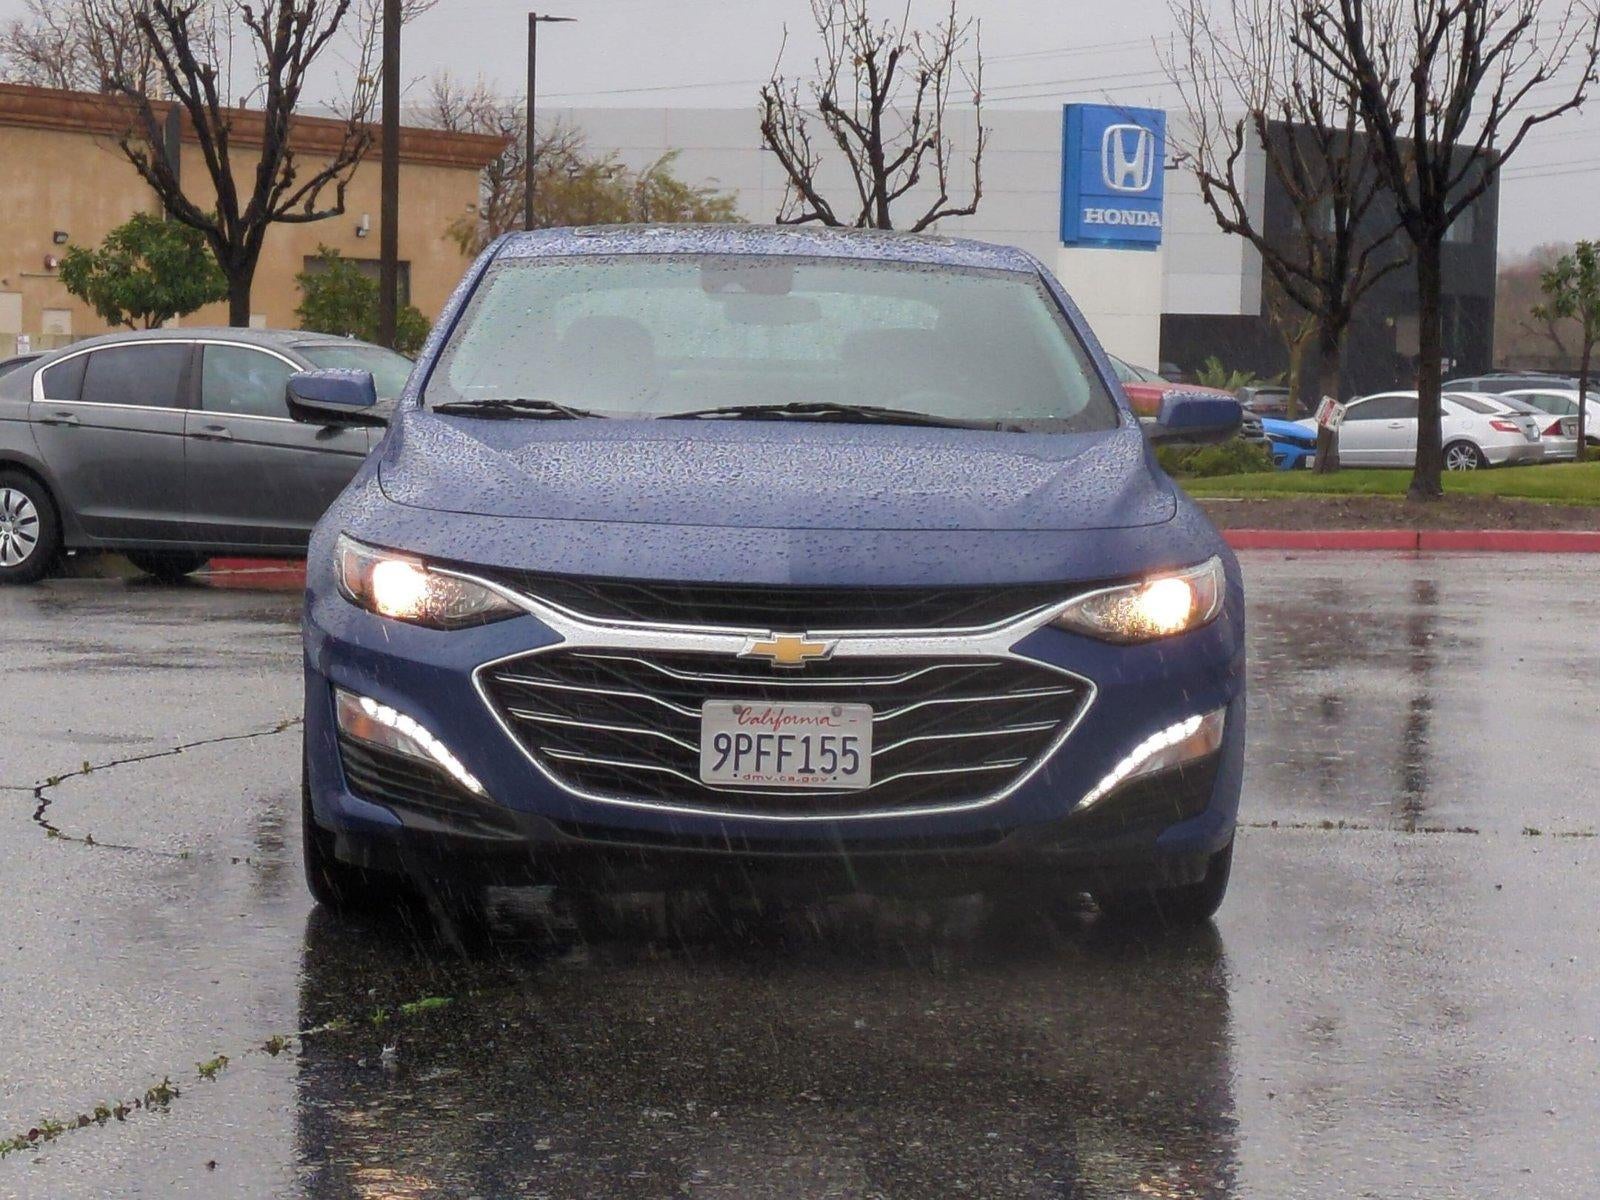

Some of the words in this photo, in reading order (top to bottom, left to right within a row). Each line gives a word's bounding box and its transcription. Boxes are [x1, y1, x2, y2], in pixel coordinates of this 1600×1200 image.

[1084, 208, 1162, 227] HONDA
[737, 706, 841, 732] California
[712, 732, 860, 775] 9PFF155
[742, 772, 828, 783] dmv.ca.gov
